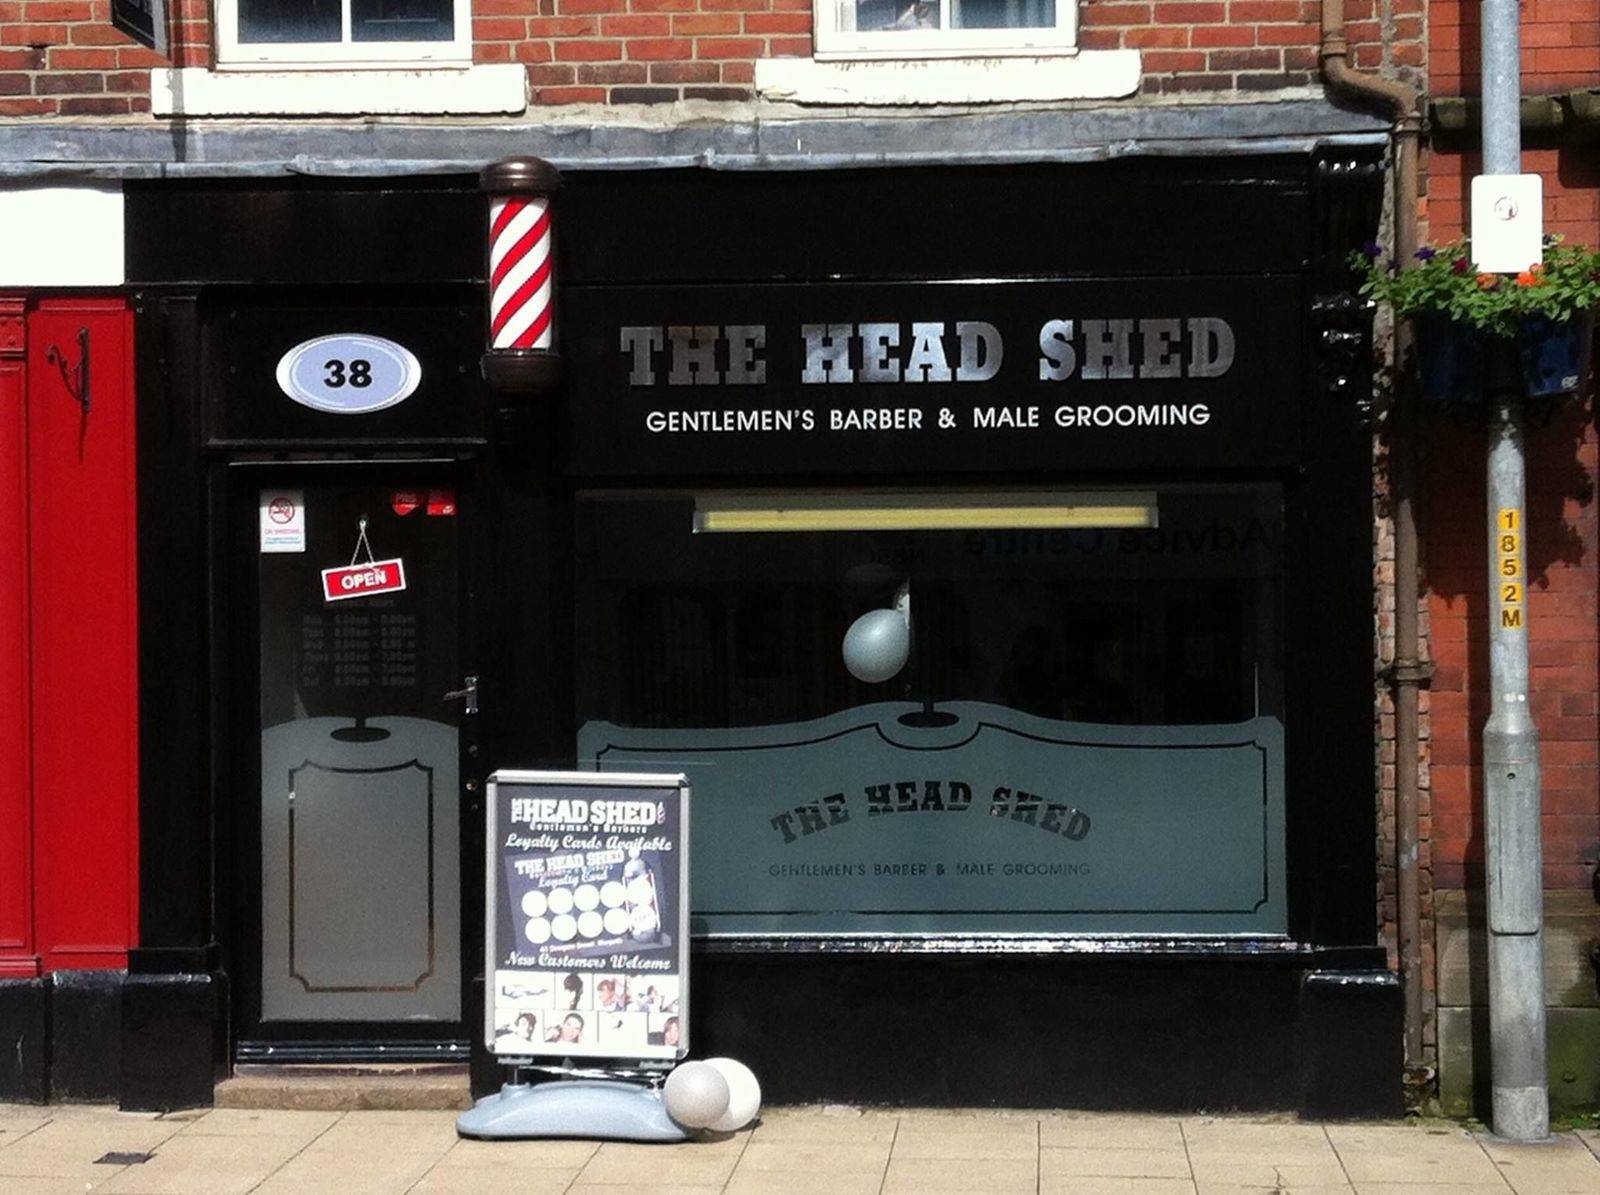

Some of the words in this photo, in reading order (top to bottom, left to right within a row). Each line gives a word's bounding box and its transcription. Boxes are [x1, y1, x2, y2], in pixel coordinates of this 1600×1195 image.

[620, 325, 766, 386] THE
[801, 321, 1003, 384] HEAD
[1039, 317, 1235, 381] SHED
[323, 359, 372, 388] 38
[646, 409, 815, 432] GENTLEMEN'S
[829, 407, 922, 430] BARBER
[938, 407, 956, 428] &
[973, 406, 1039, 428] MALE
[1054, 403, 1211, 427] GROOMING
[341, 570, 387, 590] OPEN
[522, 798, 588, 823] HEAD
[590, 800, 656, 826] SHED
[770, 793, 850, 844] THE
[864, 781, 972, 816] HEAD
[989, 786, 1092, 842] SHED
[505, 833, 559, 851] Loyalty
[562, 835, 602, 849] Cards
[605, 836, 673, 851] Available
[514, 858, 545, 875] THE
[873, 863, 927, 876] BARBER
[937, 863, 945, 875] &
[956, 863, 994, 876] MALE
[1003, 863, 1091, 876] GROOMING
[505, 951, 536, 967] New
[538, 953, 606, 969] Customers
[610, 954, 672, 970] Welcome
